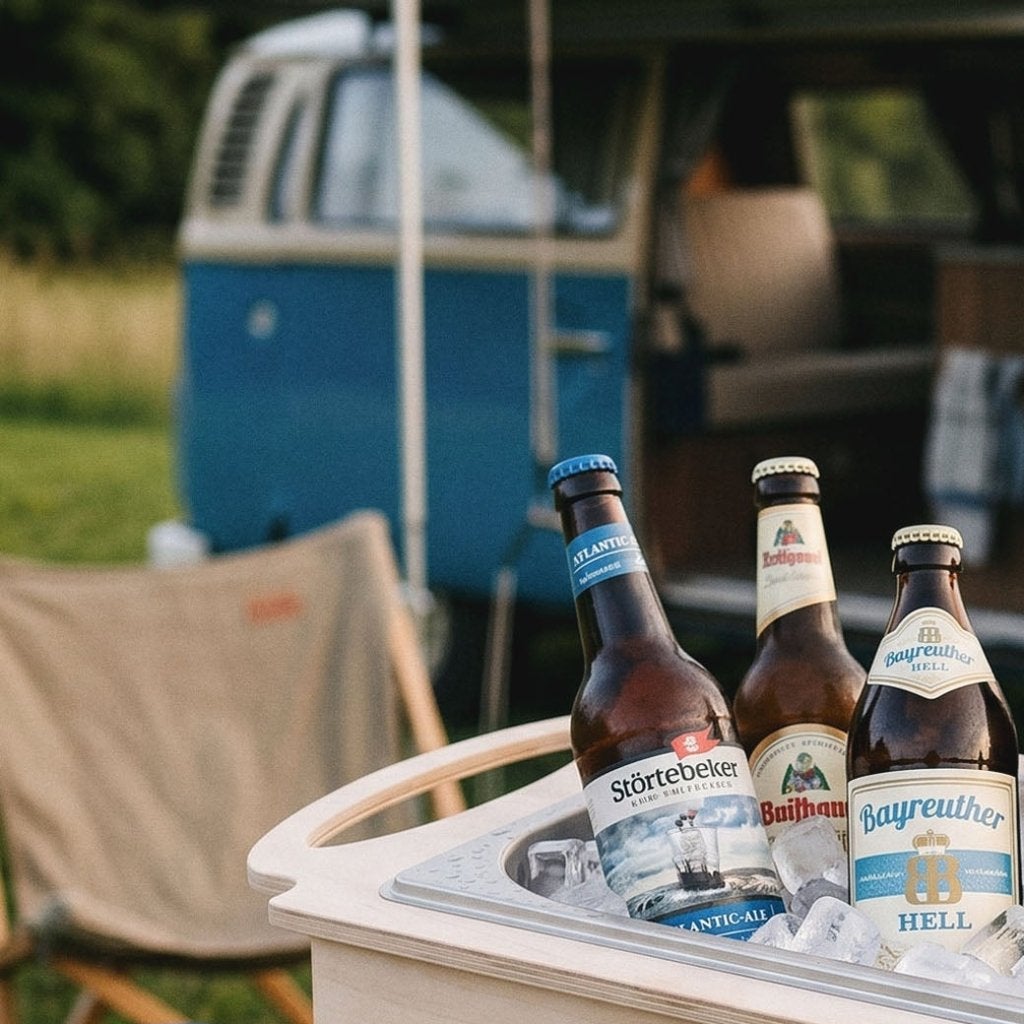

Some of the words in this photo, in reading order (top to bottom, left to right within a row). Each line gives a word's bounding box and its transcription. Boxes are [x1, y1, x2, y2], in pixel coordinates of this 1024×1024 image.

[884, 644, 975, 668] Bayreuther
[911, 662, 949, 672] HELL
[611, 759, 738, 803] Störtebeker
[860, 795, 1005, 835] Bayreuther
[899, 912, 972, 932] HELL
